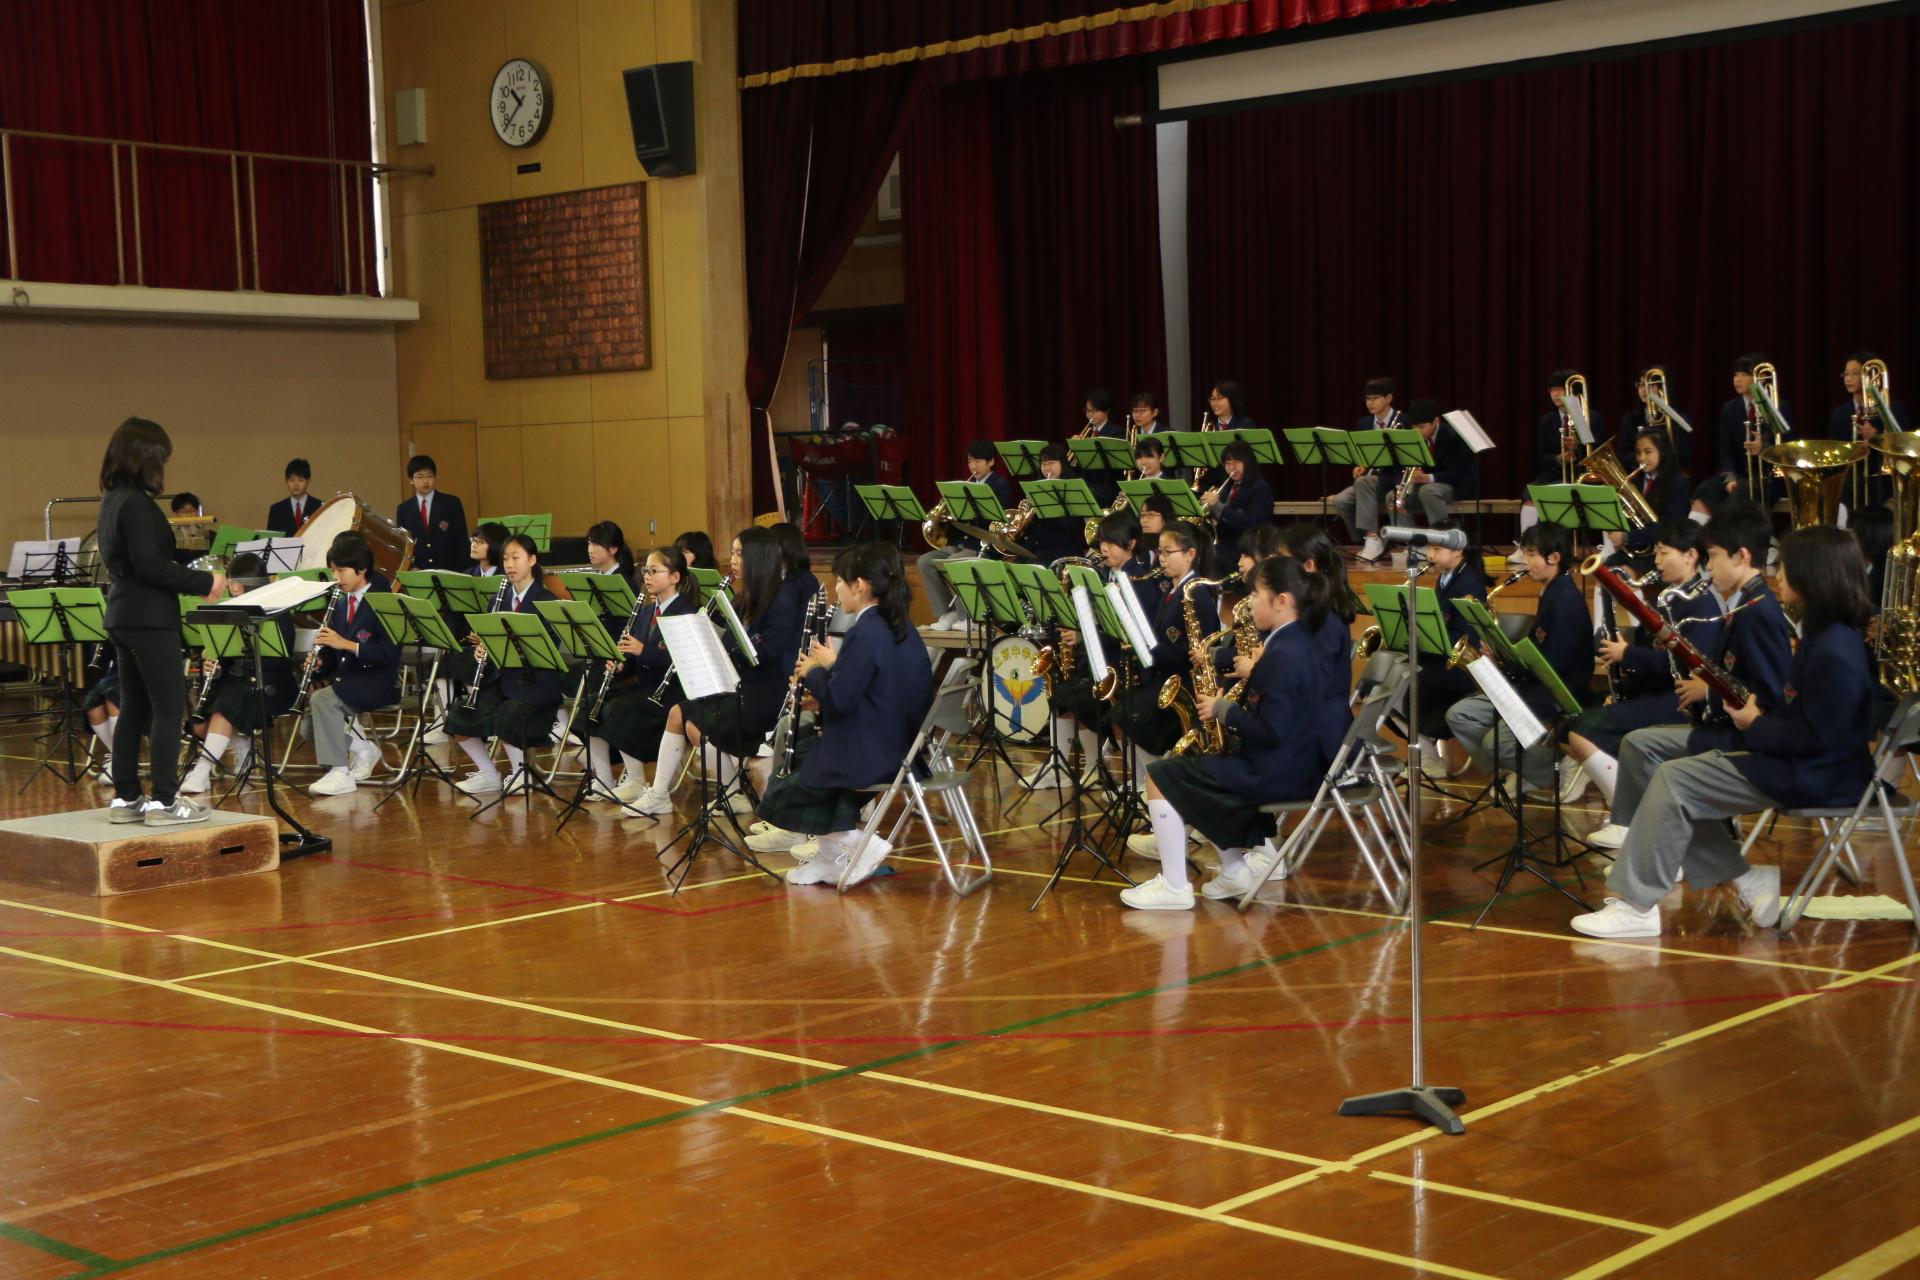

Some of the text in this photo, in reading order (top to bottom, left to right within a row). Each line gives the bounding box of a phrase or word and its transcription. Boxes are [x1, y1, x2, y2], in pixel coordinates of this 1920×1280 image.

[507, 72, 516, 86] 11
[517, 69, 525, 81] 12
[533, 80, 539, 91] 2
[499, 86, 510, 98] 10
[536, 93, 542, 106] 3
[500, 101, 506, 113] 9
[503, 113, 510, 125] 8
[534, 108, 539, 119] 4
[511, 124, 517, 135] 7
[519, 126, 525, 137] 6
[528, 121, 534, 132] 5
[177, 806, 191, 818] N
